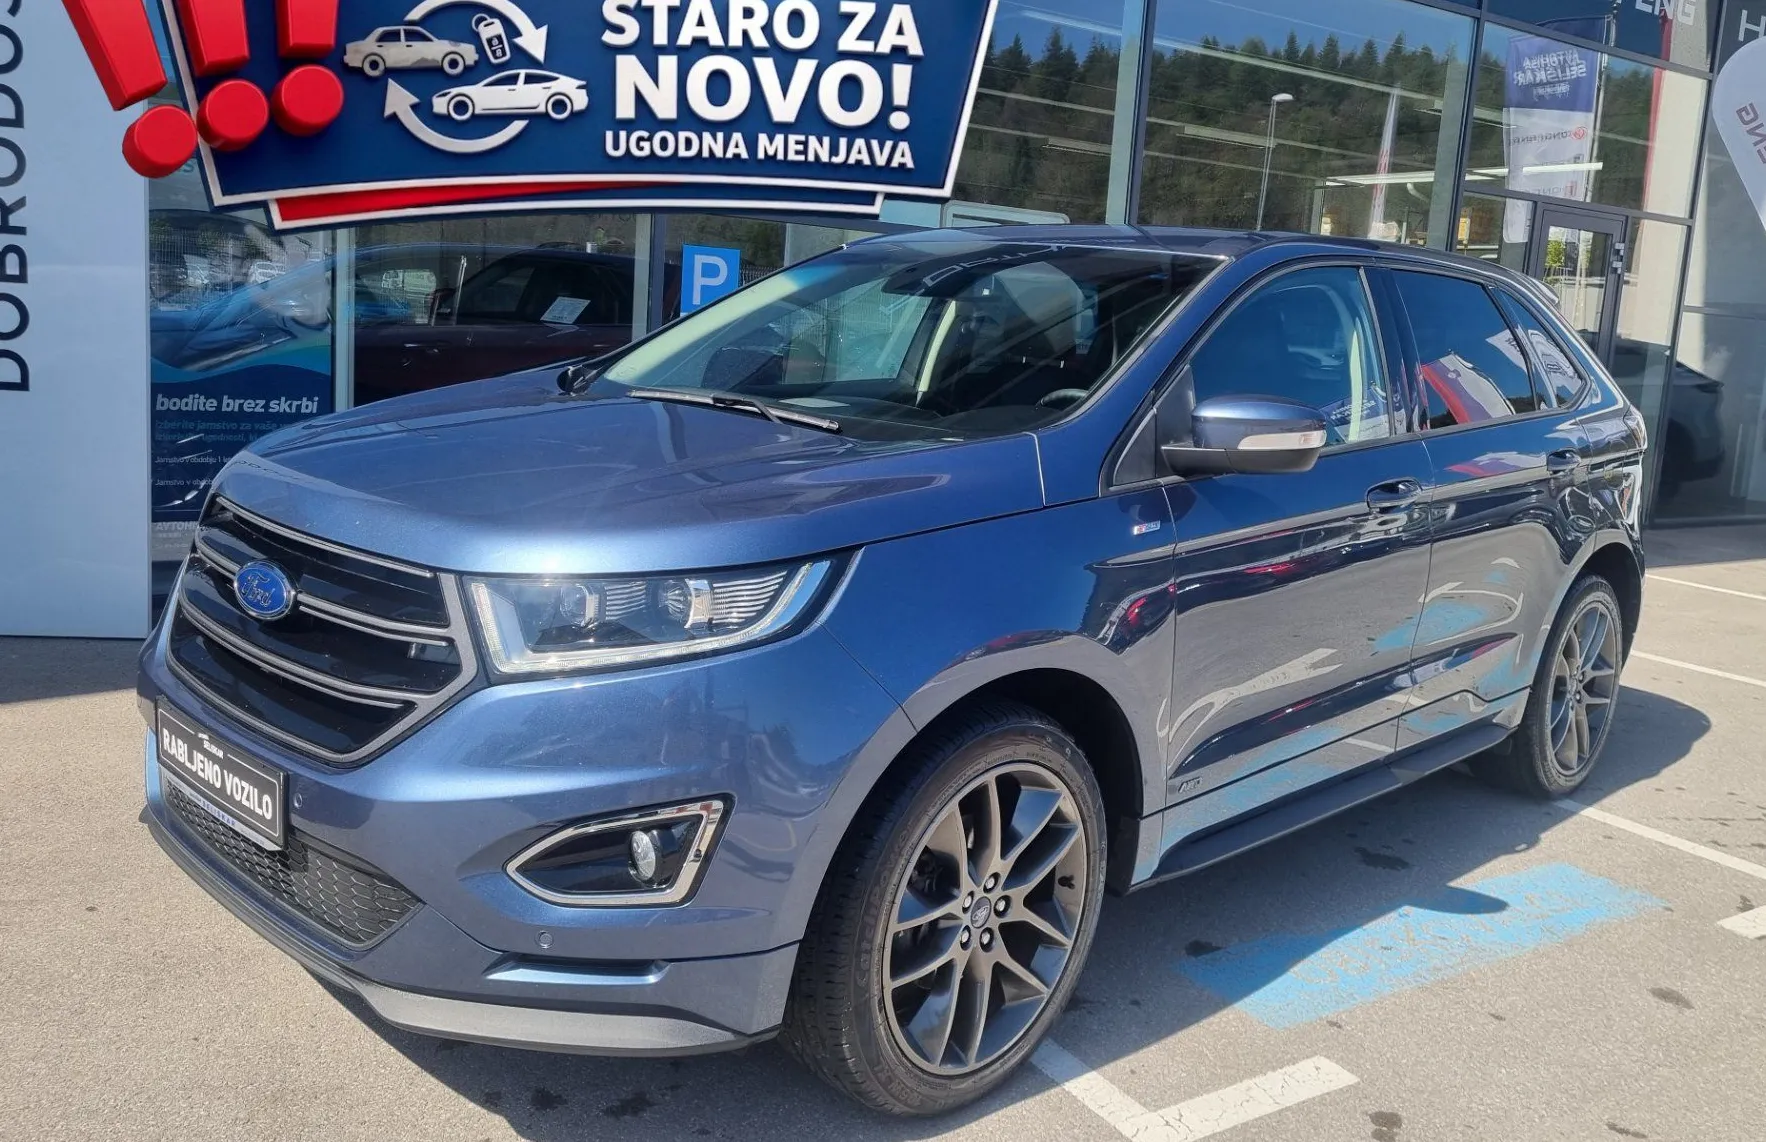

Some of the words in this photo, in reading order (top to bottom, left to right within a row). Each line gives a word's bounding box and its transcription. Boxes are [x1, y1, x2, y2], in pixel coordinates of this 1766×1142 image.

[692, 254, 728, 305] P
[156, 394, 217, 412] bodite
[221, 395, 265, 413] brez
[268, 396, 319, 414] skrbi
[239, 572, 277, 609] Ford
[162, 728, 222, 789] RABLJENO
[223, 769, 273, 820] VOZILO
